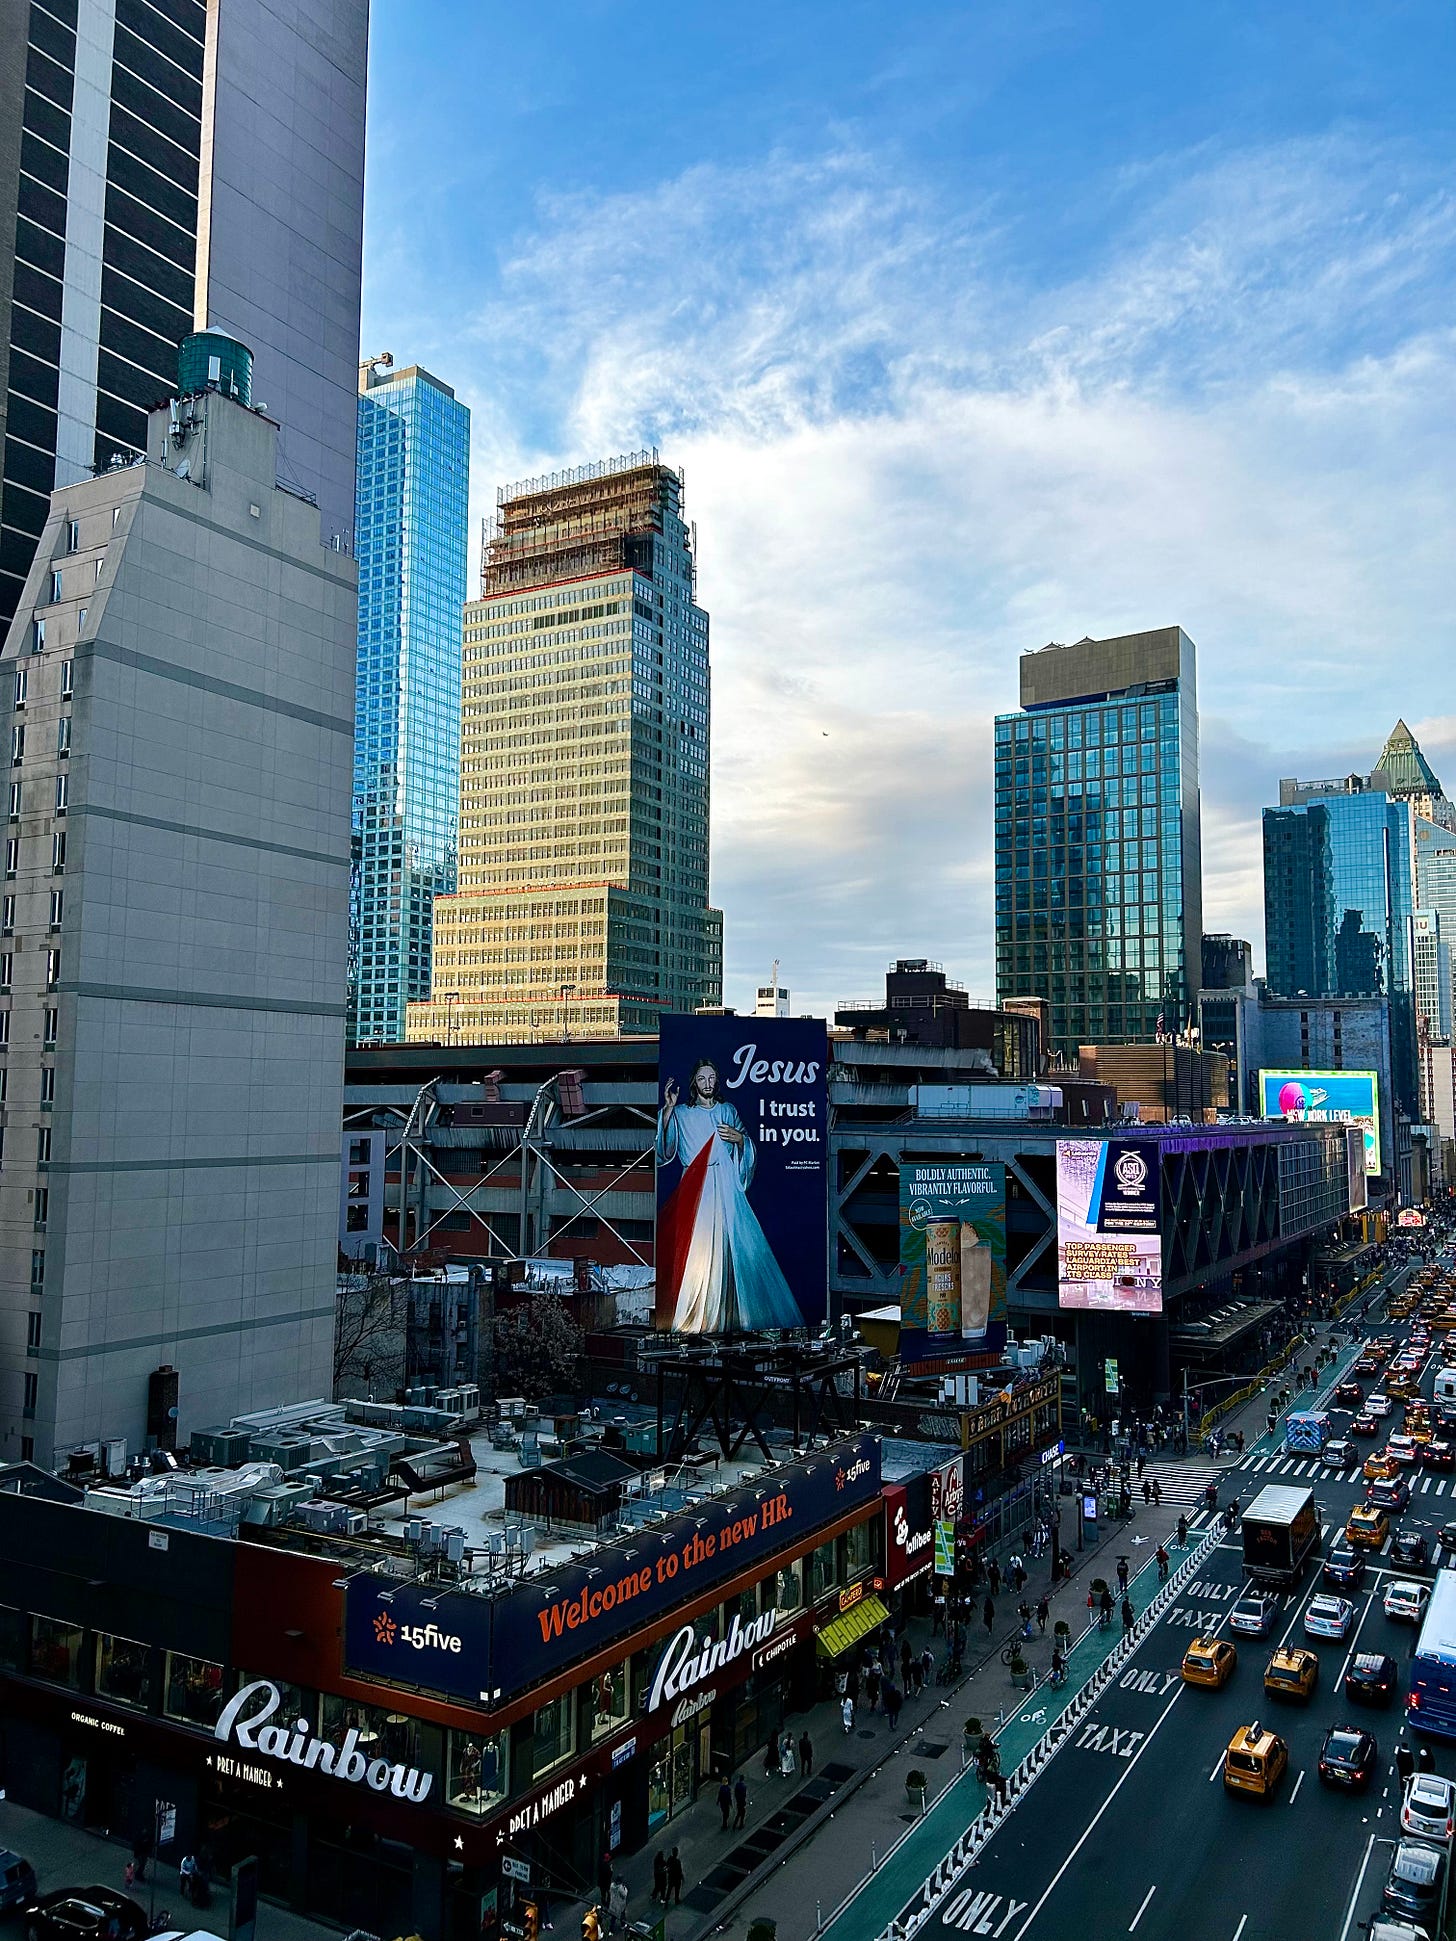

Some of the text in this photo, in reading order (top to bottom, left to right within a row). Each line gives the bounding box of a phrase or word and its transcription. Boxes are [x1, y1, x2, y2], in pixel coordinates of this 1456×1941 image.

[726, 1044, 820, 1088] Jesus
[760, 1099, 815, 1117] I trust
[759, 1123, 820, 1146] in you.
[916, 1168, 991, 1181] BOLDLY AUTHENTIC.
[909, 1182, 997, 1195] VIBRANTLY FLAVORFUL.
[1066, 1242, 1136, 1252] TOP PASSENGER
[1066, 1250, 1129, 1259] SURVEY RATES
[1066, 1257, 1140, 1266] LAGUARDIA BEST
[1106, 1265, 1117, 1273] IN
[1084, 1271, 1112, 1279] CLASS
[1134, 1276, 1161, 1289] NY
[1041, 1443, 1060, 1464] CHASE
[846, 1459, 870, 1482] 15five
[537, 1493, 793, 1643] Welcome to the new HR.
[1187, 1581, 1238, 1600] ONLY
[1166, 1607, 1222, 1631] TAXI
[401, 1623, 462, 1653] 15five
[765, 1633, 797, 1662] CHIPOTLE
[648, 1607, 777, 1713] Rainbow
[1119, 1668, 1179, 1695] ONLY
[670, 1688, 717, 1728] Rainbow
[71, 1711, 126, 1736] ORGANIC COFFEE
[214, 1679, 433, 1803] Rainbow
[1075, 1723, 1145, 1757] TAXI
[216, 1755, 273, 1788] PRET A MANGER
[509, 1778, 575, 1840] PRET A MANGER
[942, 1888, 1028, 1939] ONLY
